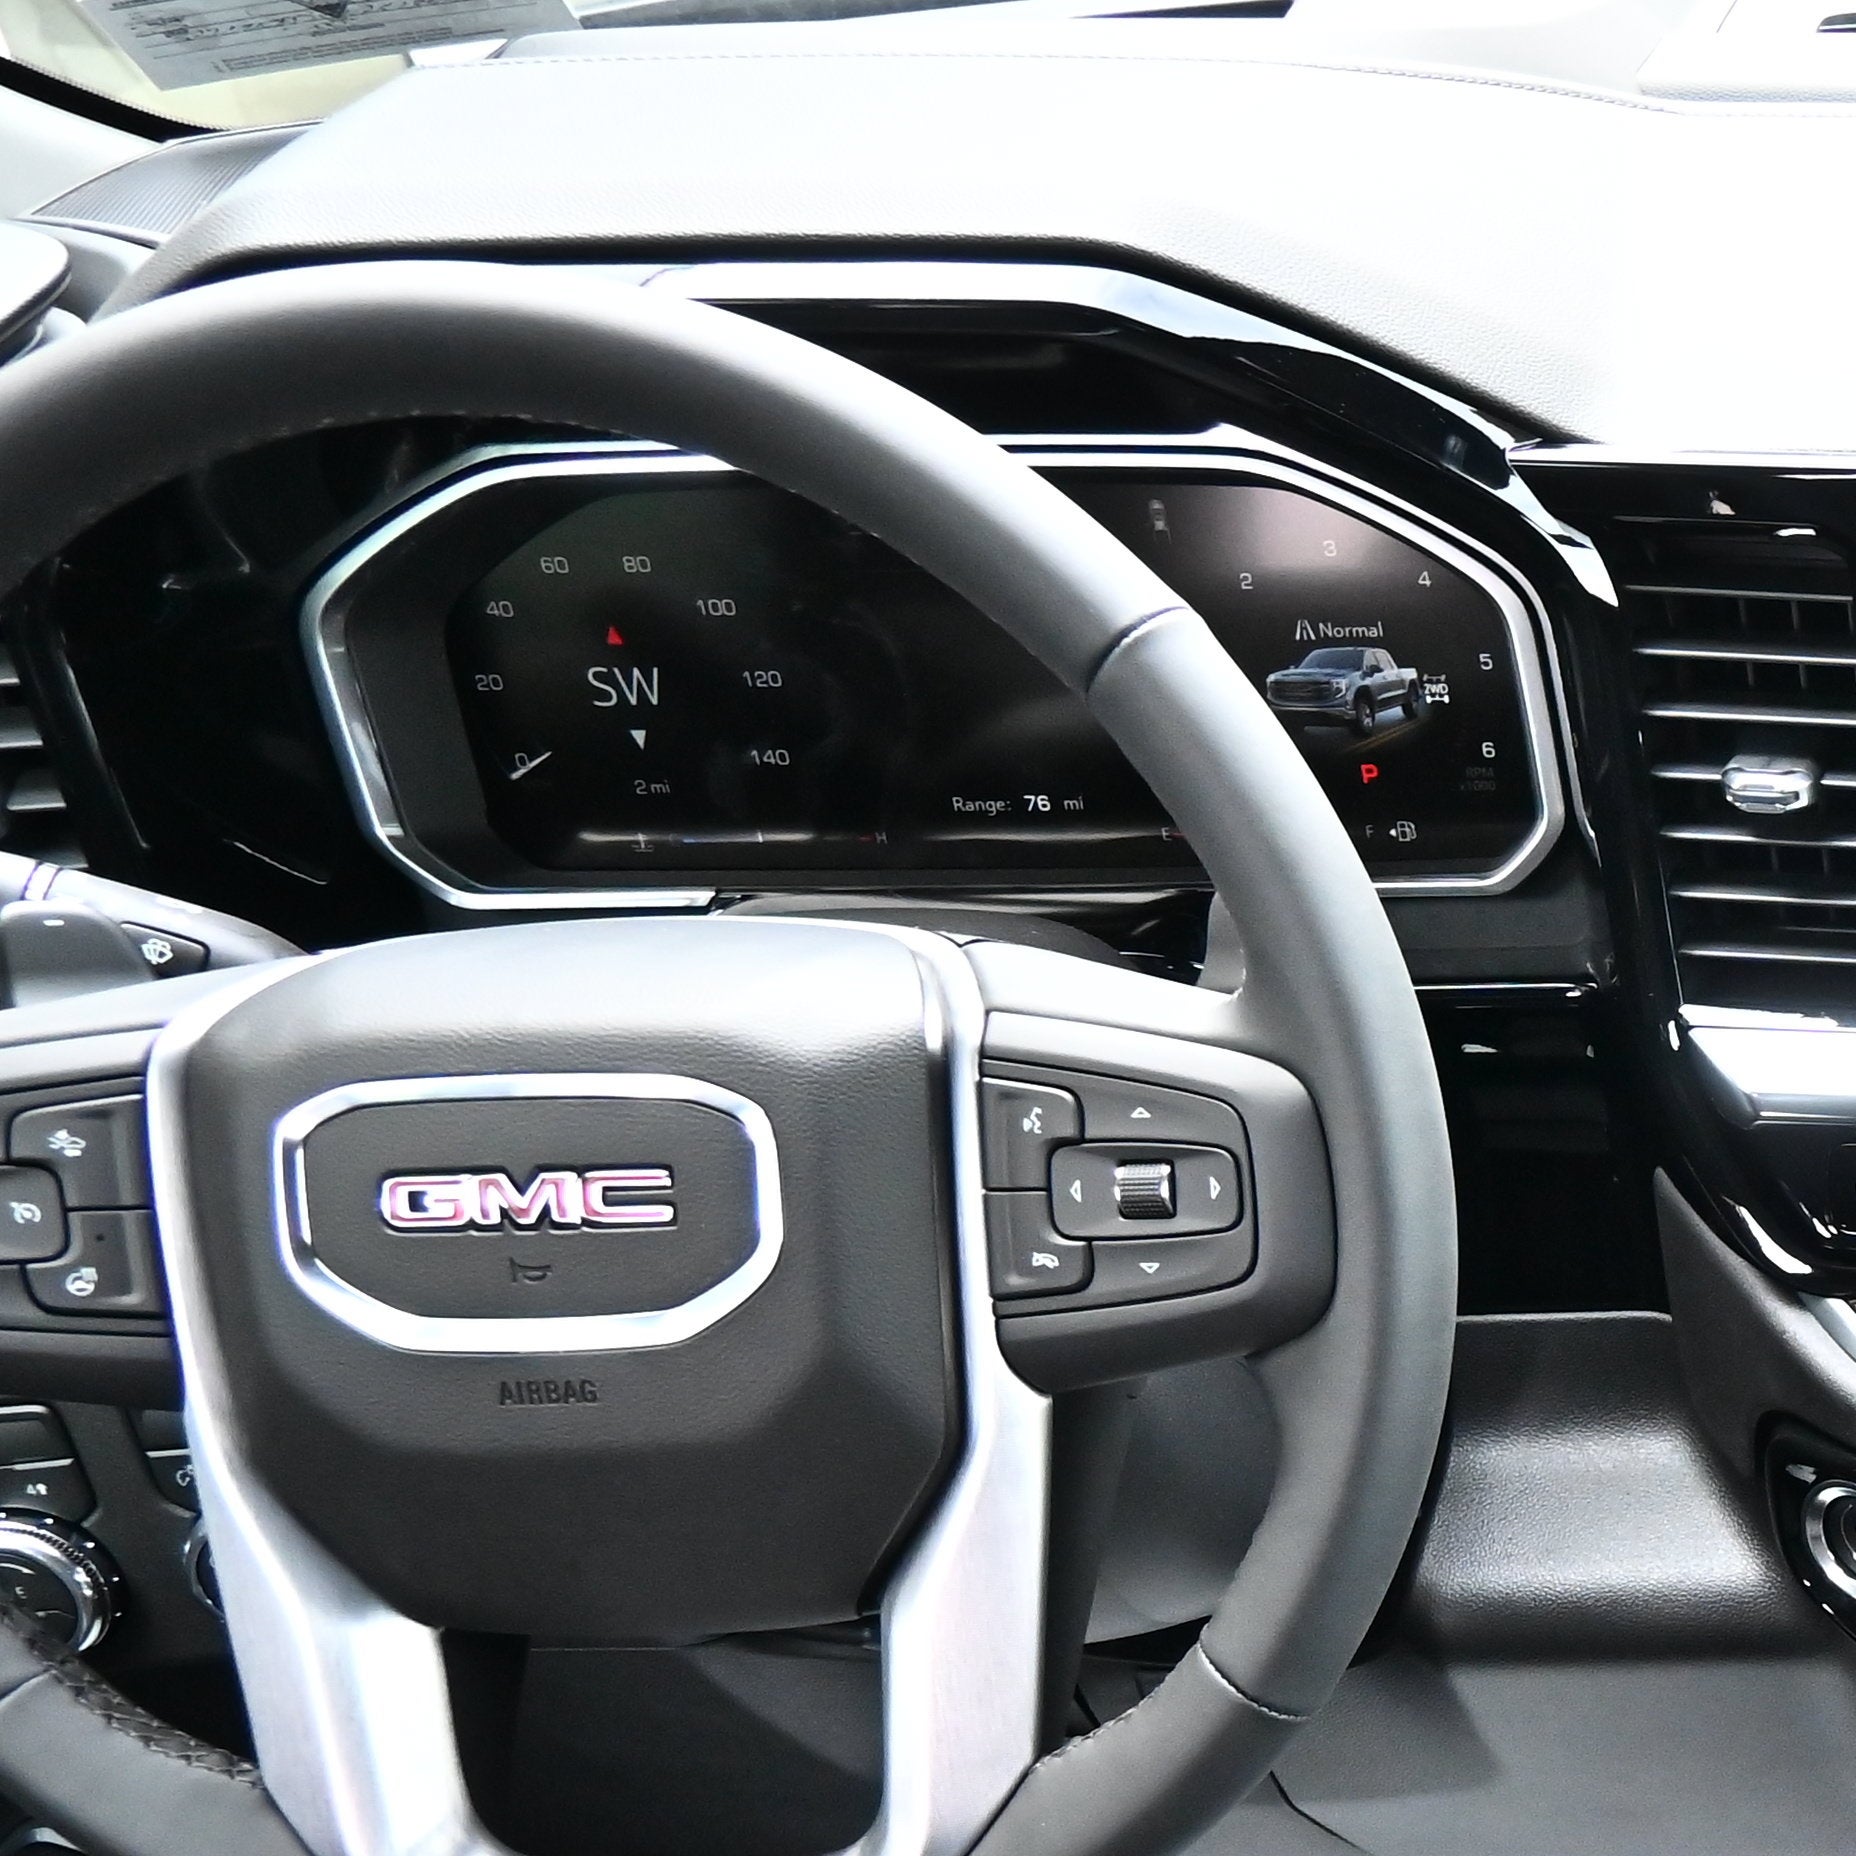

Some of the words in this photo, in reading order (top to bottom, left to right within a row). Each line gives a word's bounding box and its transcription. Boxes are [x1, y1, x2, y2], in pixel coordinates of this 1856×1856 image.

[1323, 541, 1337, 556] 3
[540, 556, 569, 574] 60
[623, 555, 651, 573] 80
[1239, 573, 1253, 589] 2
[1418, 571, 1431, 587] 4
[486, 600, 514, 618] 40
[696, 599, 736, 617] 100
[1319, 621, 1383, 638] Normal
[1479, 653, 1493, 670] 5
[475, 674, 503, 691] 20
[587, 666, 659, 707] SW
[743, 671, 782, 688] 120
[750, 749, 790, 767] 140
[1482, 742, 1496, 758] 6
[1361, 764, 1378, 783] P
[633, 780, 647, 795] 2
[651, 779, 671, 794] mi
[952, 797, 1012, 816] Range:
[1023, 795, 1051, 812] 76
[1064, 796, 1084, 811] mi
[1161, 827, 1171, 841] E
[1366, 825, 1375, 839] F
[380, 1168, 675, 1228] GMC
[500, 1379, 598, 1406] AIRBAG
